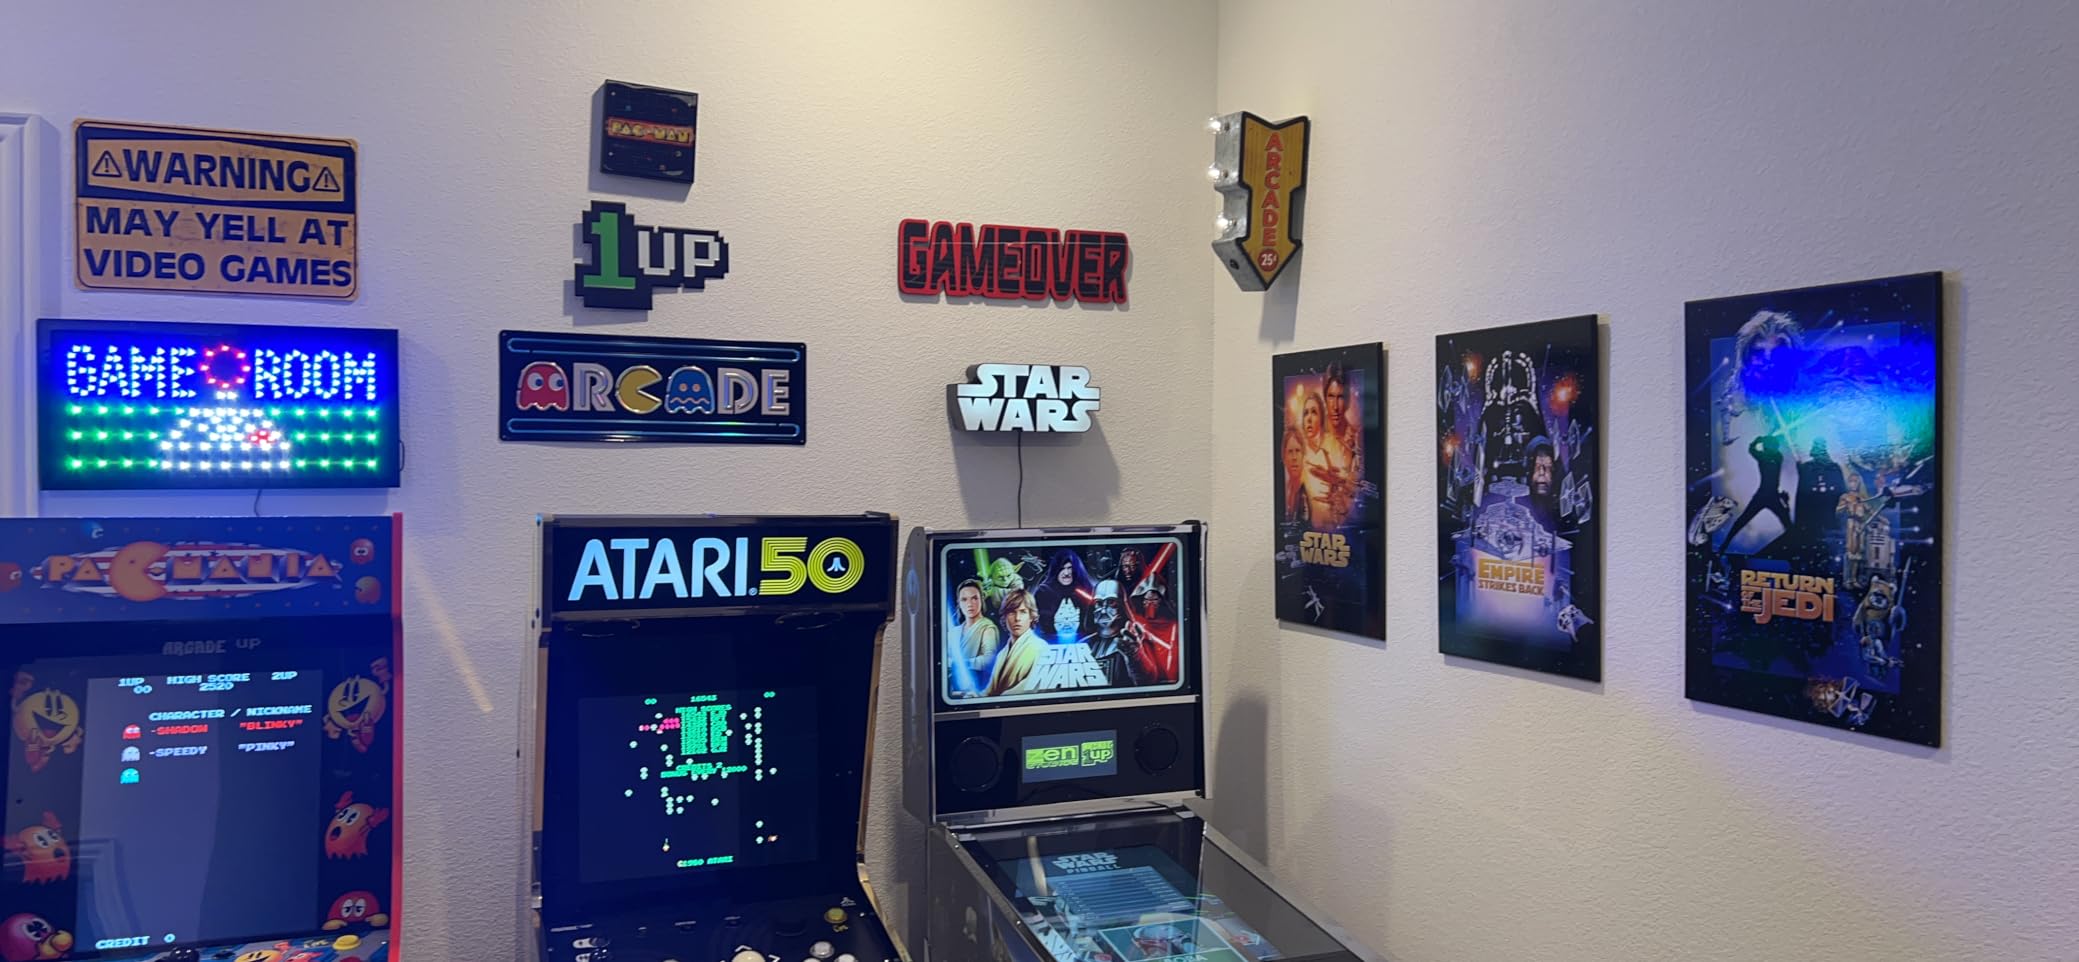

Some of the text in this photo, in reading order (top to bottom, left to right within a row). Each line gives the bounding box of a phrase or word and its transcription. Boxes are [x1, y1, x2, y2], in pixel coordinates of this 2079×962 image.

[611, 121, 688, 142] PAC-MAN
[123, 149, 311, 193] WARNING
[1260, 132, 1284, 247] ARCADE
[86, 206, 350, 246] MAY YELL AT
[583, 212, 720, 290] 1UP
[84, 249, 352, 287] VIDEO GAMES
[67, 345, 377, 401] GAME ROOM
[957, 363, 1101, 399] STAR
[516, 361, 791, 416] ARCADE
[957, 398, 1101, 432] WARS
[1300, 531, 1351, 552] STAR
[759, 537, 865, 594] 50
[1300, 546, 1351, 567] WARS
[1478, 559, 1545, 585] EMPIRE
[1741, 569, 1835, 594] RETURN
[1478, 579, 1545, 596] STRIKES BACK
[1754, 587, 1835, 624] JEDI
[162, 639, 227, 656] ARCADE
[1036, 643, 1096, 664] STAR
[118, 671, 298, 687] 1UP HIGH SCORE 2UP
[133, 682, 234, 694] 00 2520
[1024, 661, 1110, 692] WARS
[149, 709, 225, 721] CHARACTER
[246, 705, 312, 717] NICKNAME
[1052, 858, 1118, 869] WARS
[1056, 851, 1119, 863] STAR
[1066, 864, 1120, 875] PINBALL
[95, 933, 176, 950] CREDIT 0
